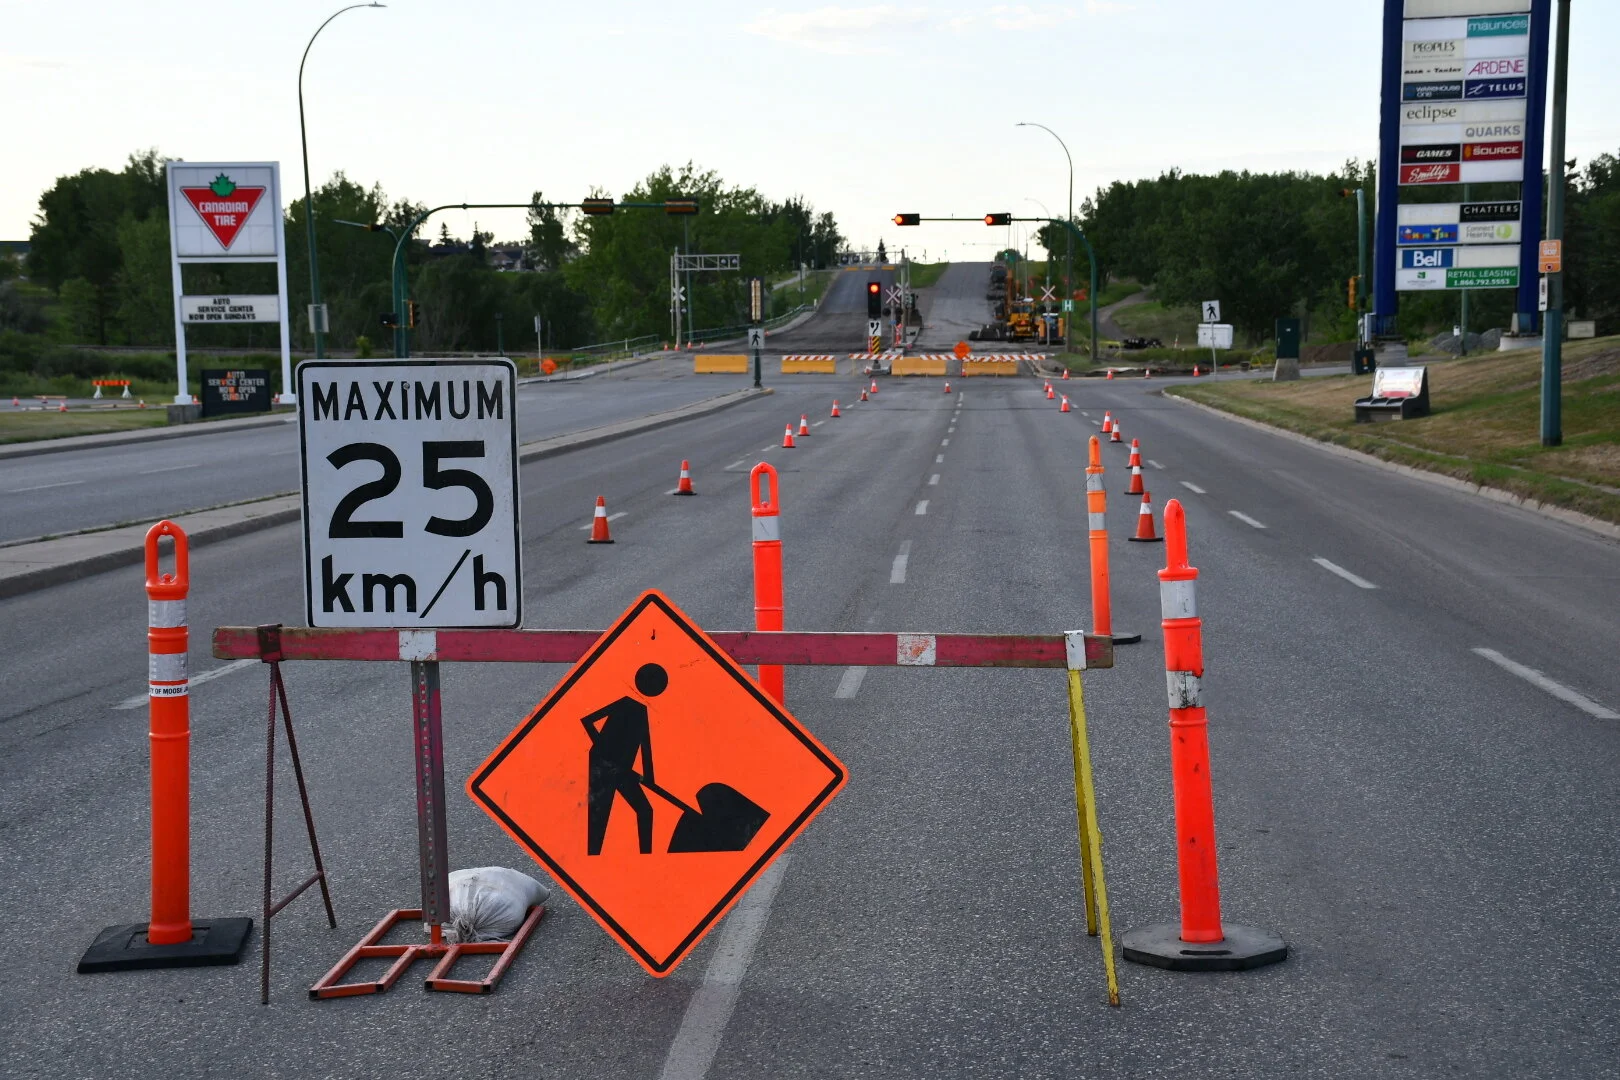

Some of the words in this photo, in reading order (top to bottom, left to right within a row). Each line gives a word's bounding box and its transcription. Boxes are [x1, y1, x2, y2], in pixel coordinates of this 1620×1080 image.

[1468, 20, 1527, 31] maurices
[1412, 41, 1455, 53] PEOPLES
[1468, 59, 1524, 76] ARDENE
[1488, 83, 1524, 92] TELUS
[1406, 105, 1457, 122] eclipse
[1465, 125, 1520, 137] QUARKS
[1416, 149, 1453, 158] GAMES
[1473, 145, 1519, 155] SOURCE
[199, 202, 248, 213] CANADIAN
[1463, 204, 1519, 215] CHATTERS
[214, 214, 236, 226] TIRE
[1466, 224, 1495, 232] Connect
[1466, 231, 1494, 239] Hearing
[1413, 250, 1442, 267] Bell
[1447, 270, 1477, 279] RETAIL
[1480, 269, 1516, 278] LEASING
[226, 371, 245, 379] AUTO
[208, 378, 236, 386] SERVICE
[239, 378, 265, 386] CENTER
[219, 386, 236, 394] NOW
[238, 386, 256, 394] OPEN
[222, 393, 250, 401] SUNDAY
[312, 380, 503, 421] MAXIMUM
[326, 440, 494, 538] 25
[321, 549, 507, 618] km/h
[163, 687, 182, 695] MOOSE
